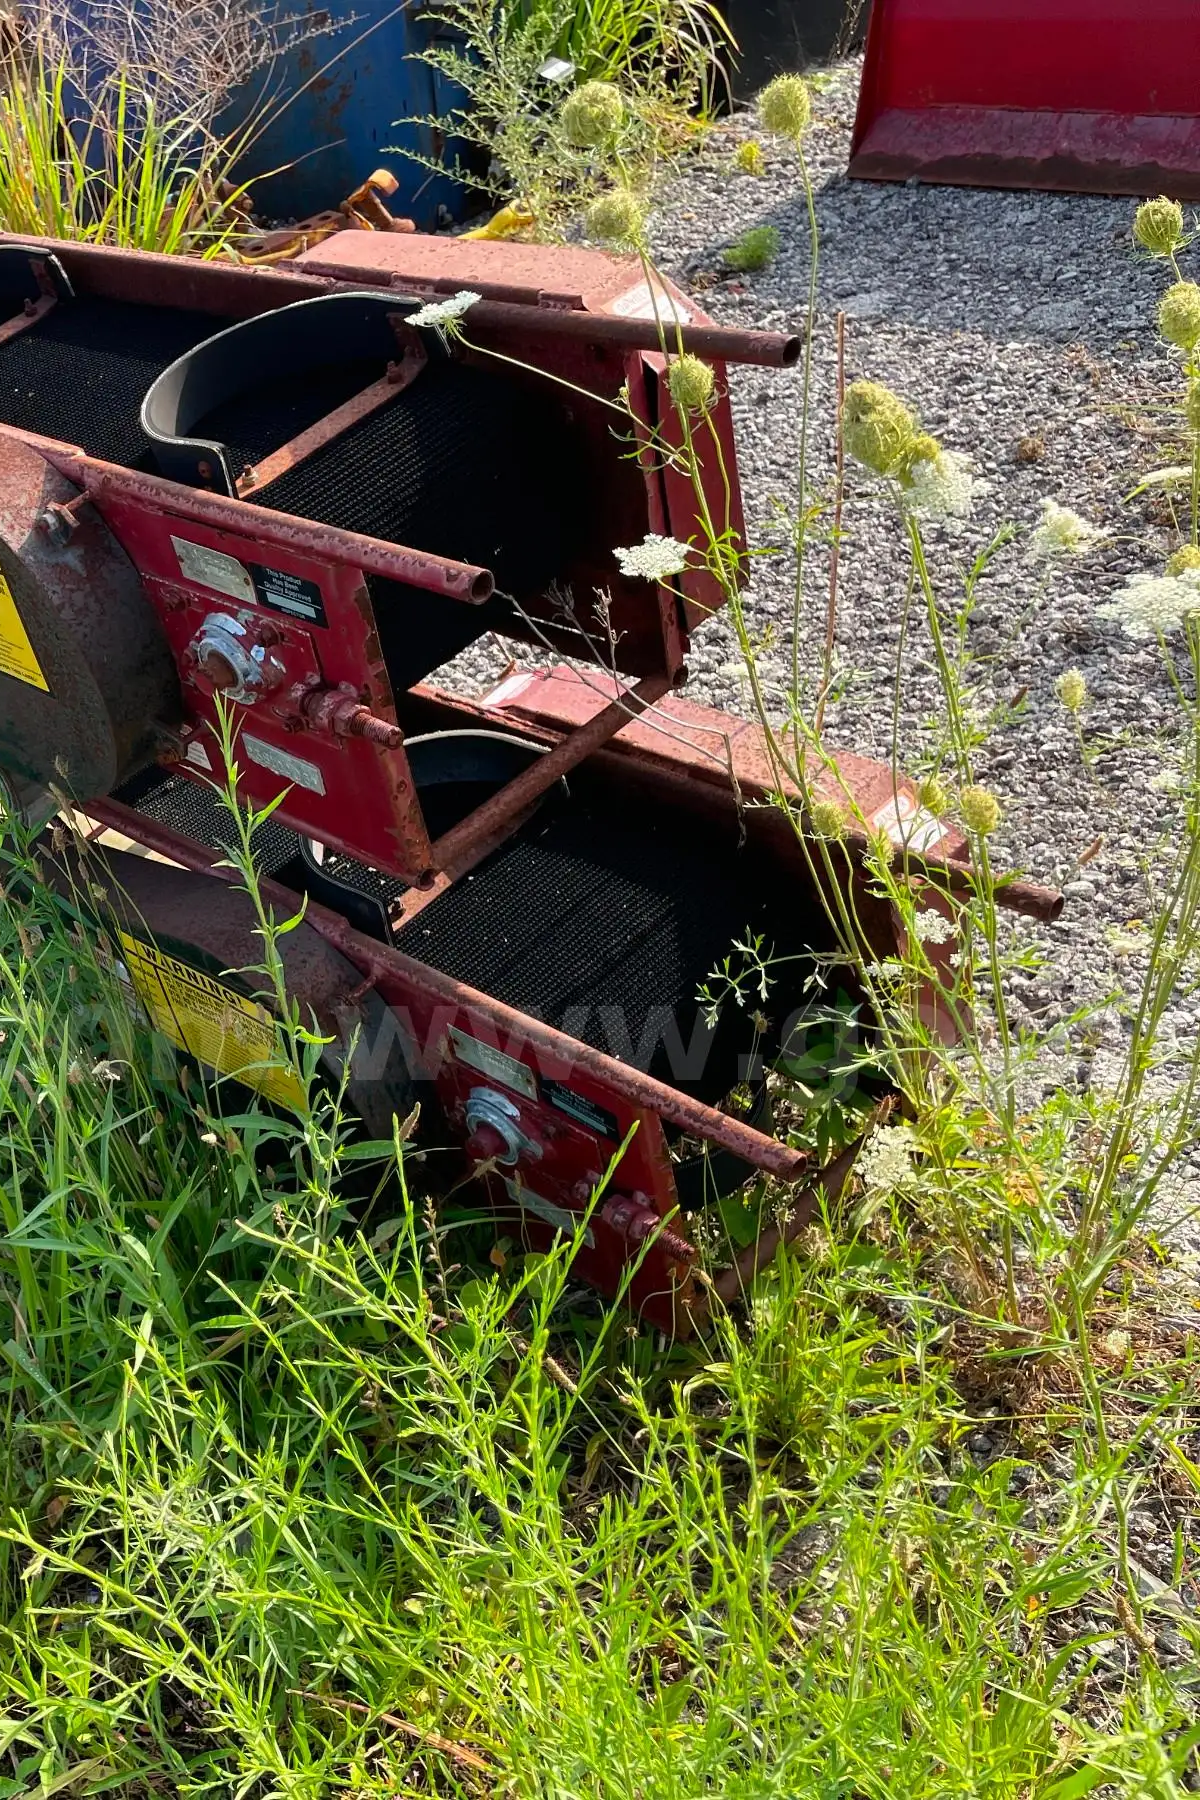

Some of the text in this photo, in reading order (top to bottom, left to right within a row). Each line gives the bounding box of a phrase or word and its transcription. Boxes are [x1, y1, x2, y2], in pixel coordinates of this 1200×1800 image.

[266, 568, 302, 586] This Product
[284, 588, 312, 603] Approved
